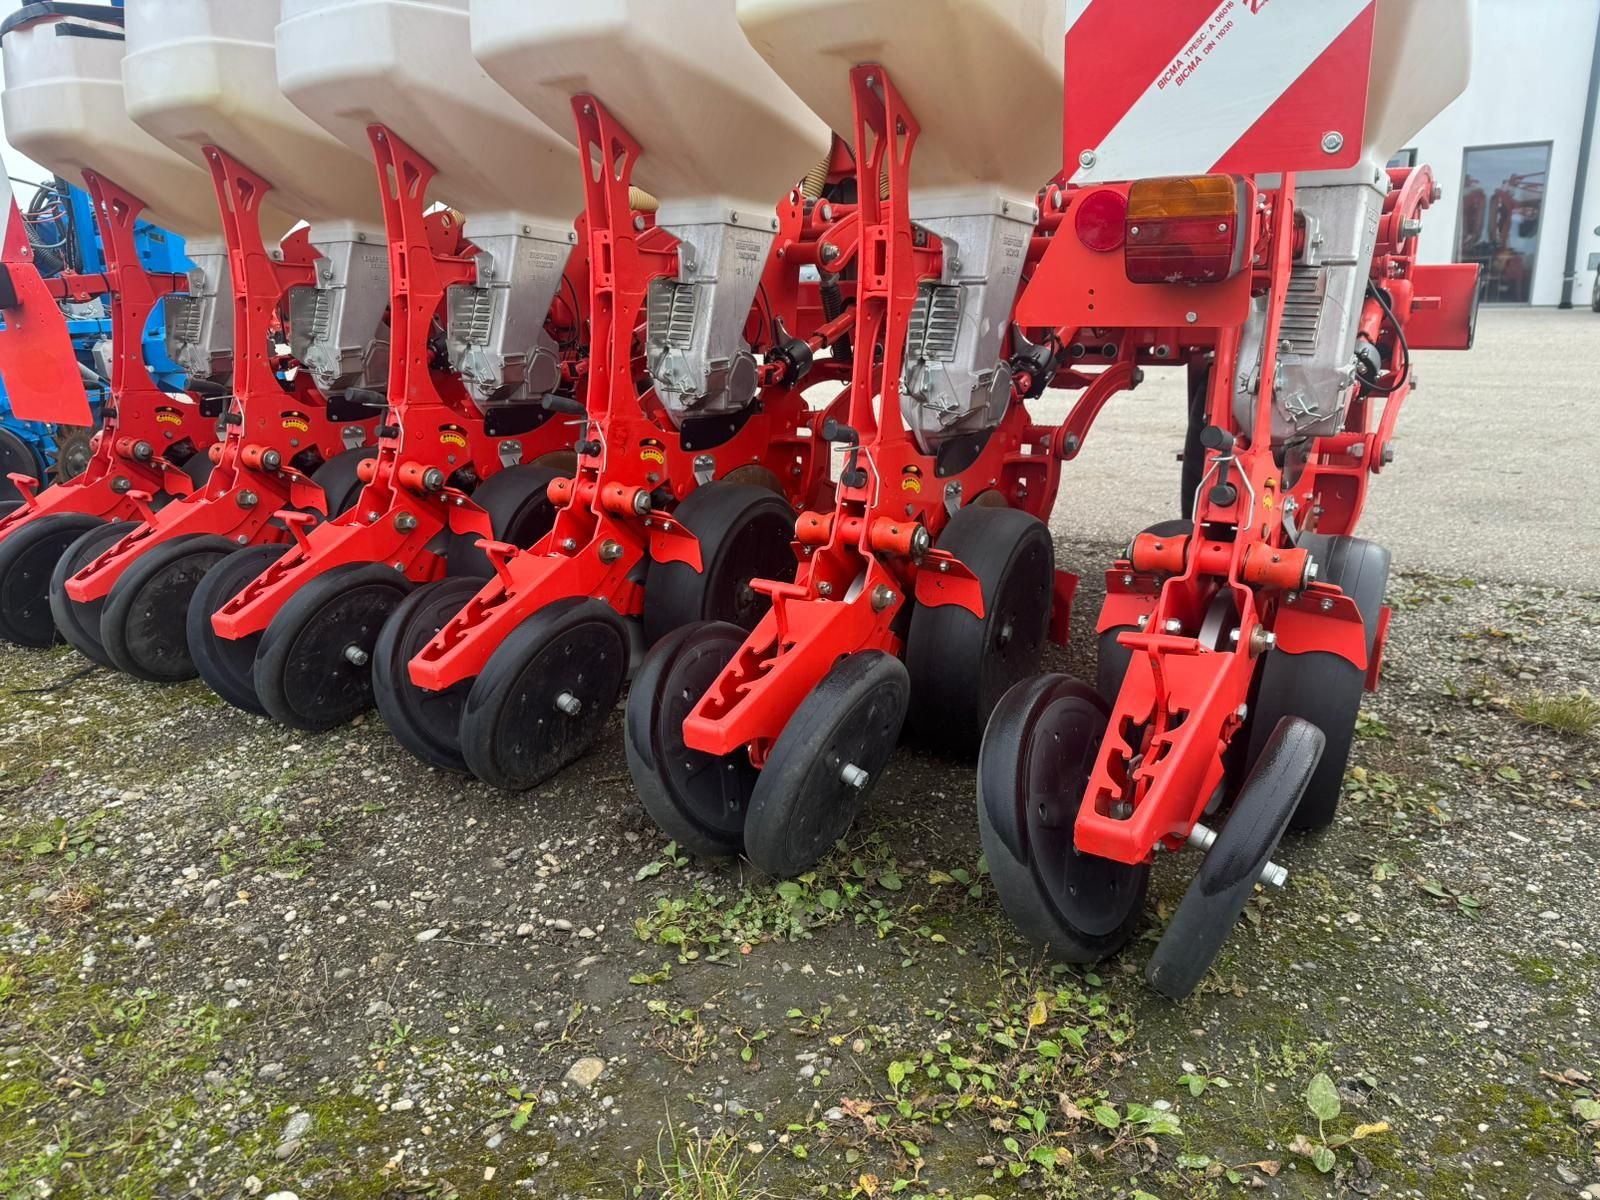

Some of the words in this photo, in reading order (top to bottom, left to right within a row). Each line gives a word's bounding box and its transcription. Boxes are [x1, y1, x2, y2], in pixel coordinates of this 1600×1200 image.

[1157, 59, 1184, 90] BICMA
[1175, 56, 1202, 86] BICMA
[1203, 40, 1216, 55] DIN
[1216, 20, 1233, 39] 11030
